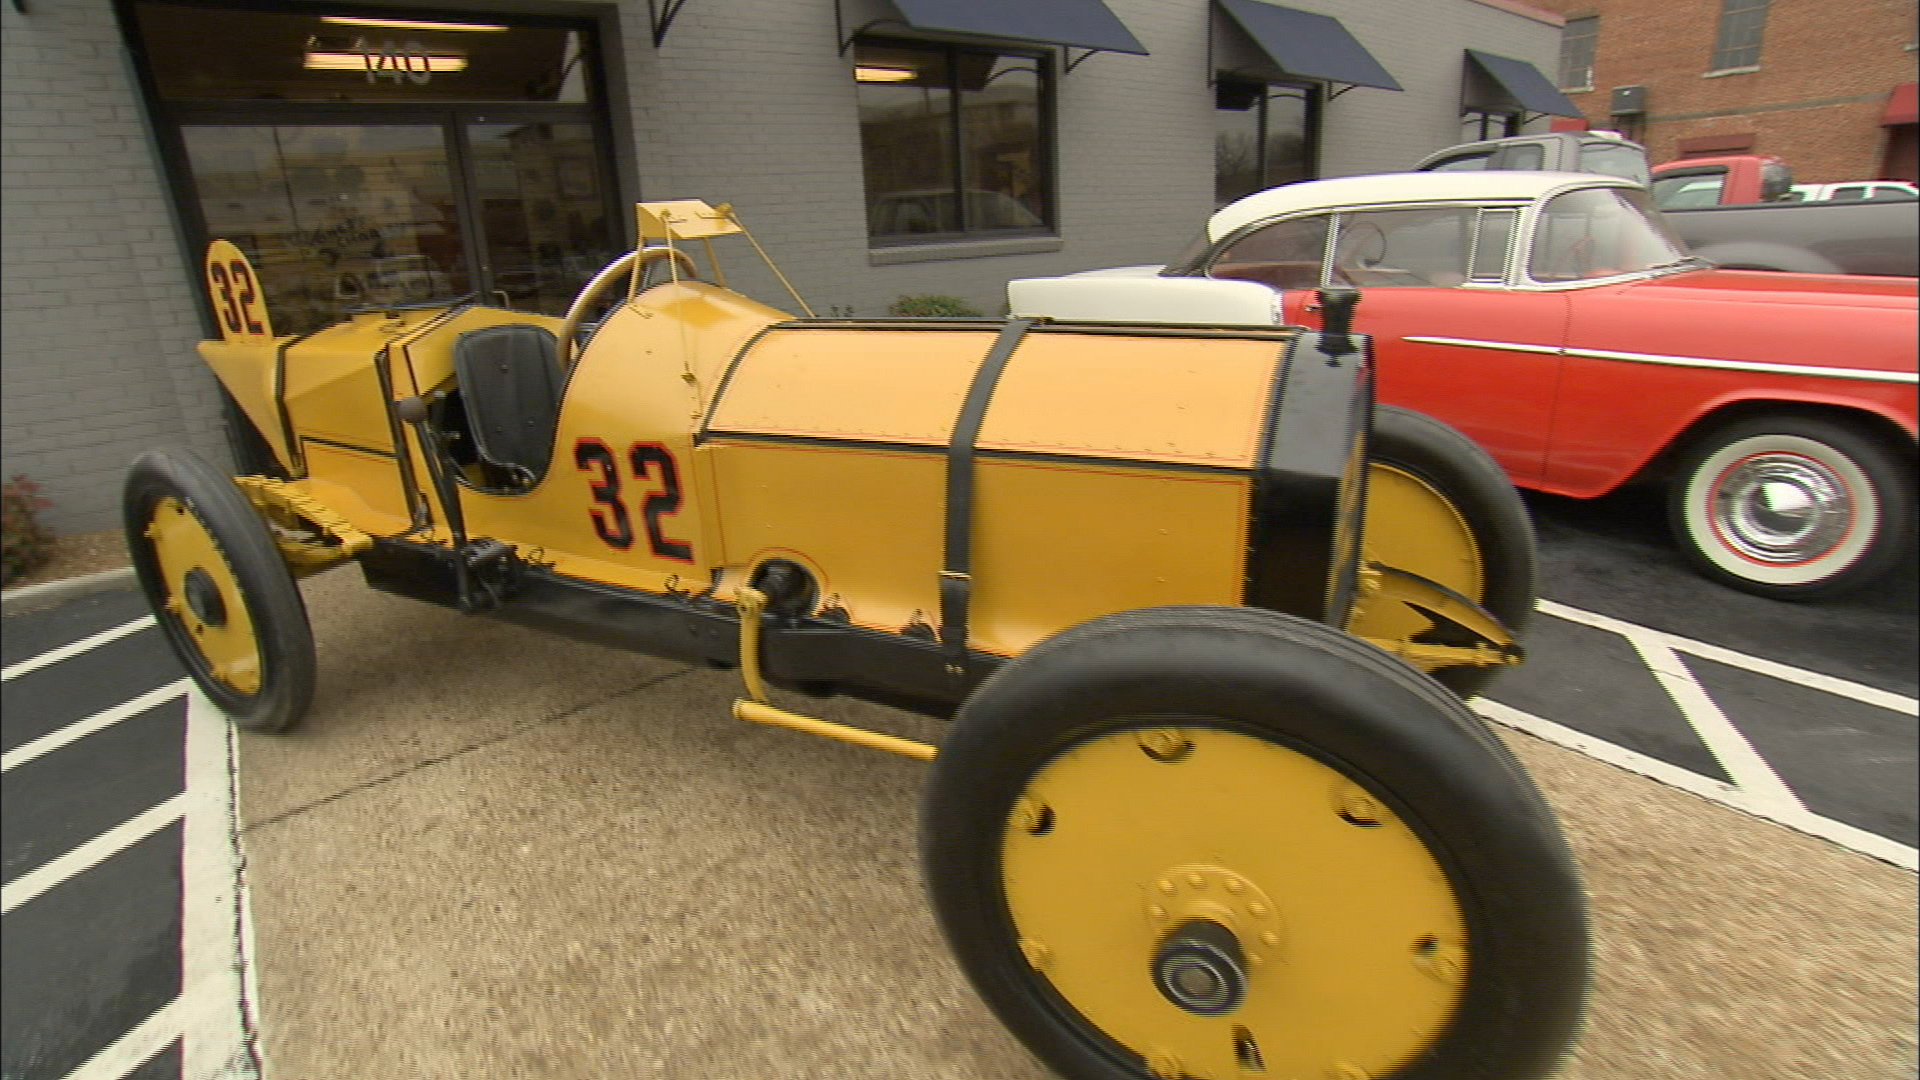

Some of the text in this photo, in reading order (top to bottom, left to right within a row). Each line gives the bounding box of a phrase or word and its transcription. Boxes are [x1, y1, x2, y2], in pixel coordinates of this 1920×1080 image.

[358, 38, 431, 85] 140
[211, 259, 266, 336] 32
[574, 437, 697, 565] 32
